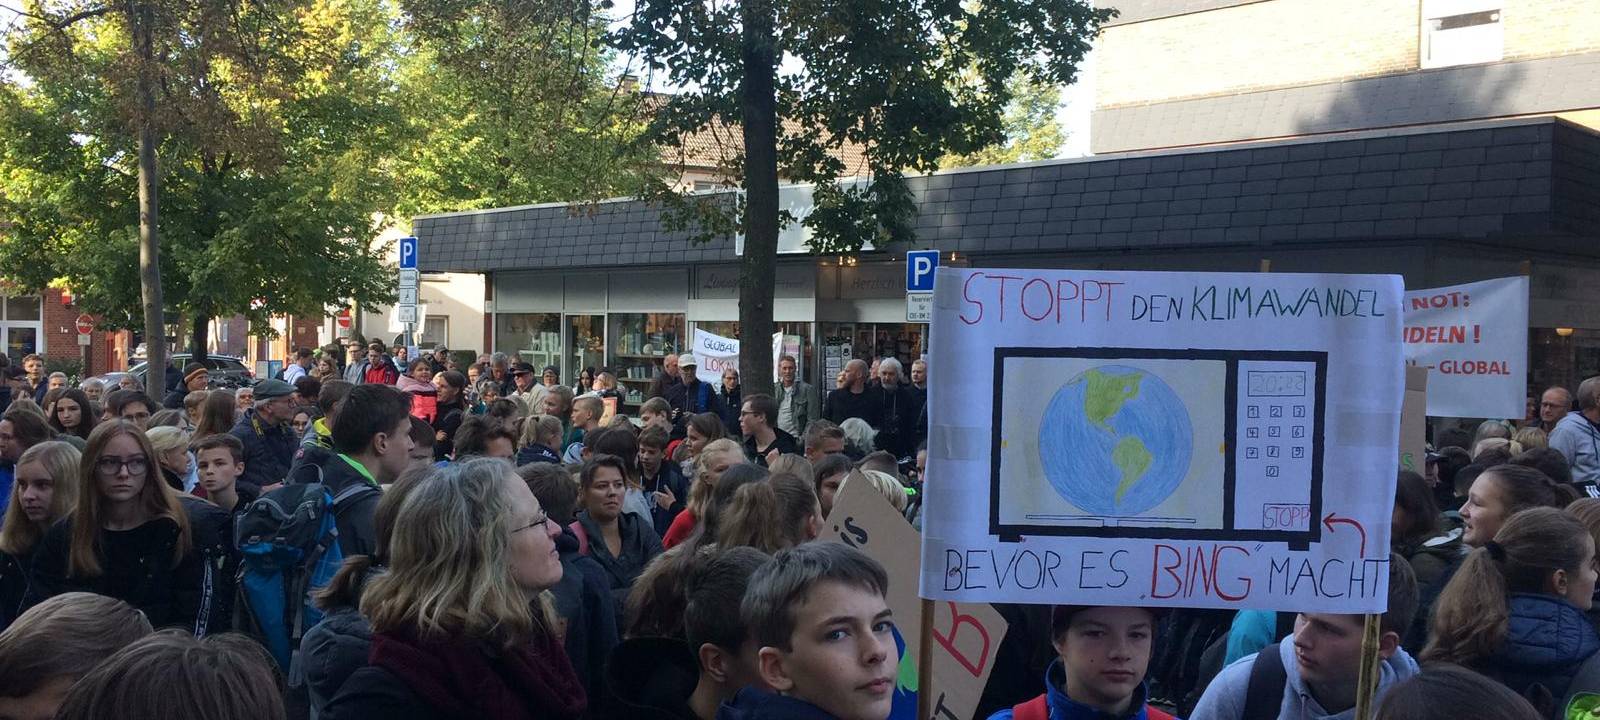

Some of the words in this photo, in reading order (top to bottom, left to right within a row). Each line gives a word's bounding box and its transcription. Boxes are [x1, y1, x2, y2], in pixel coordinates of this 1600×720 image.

[403, 242, 413, 265] P
[914, 256, 931, 286] P
[959, 272, 1125, 325] STOPPT
[1131, 294, 1182, 322] DEN
[1192, 286, 1385, 320] KLIMAWANDEL
[1411, 291, 1470, 310] NOT:
[703, 338, 737, 353] GLOBAL
[1403, 325, 1465, 343] DELN
[1440, 360, 1511, 375] GLOBAL
[1263, 506, 1310, 529] STOPP
[943, 549, 1061, 592] BEVOR
[1079, 550, 1129, 589] ES
[1268, 557, 1389, 599] MACHT
